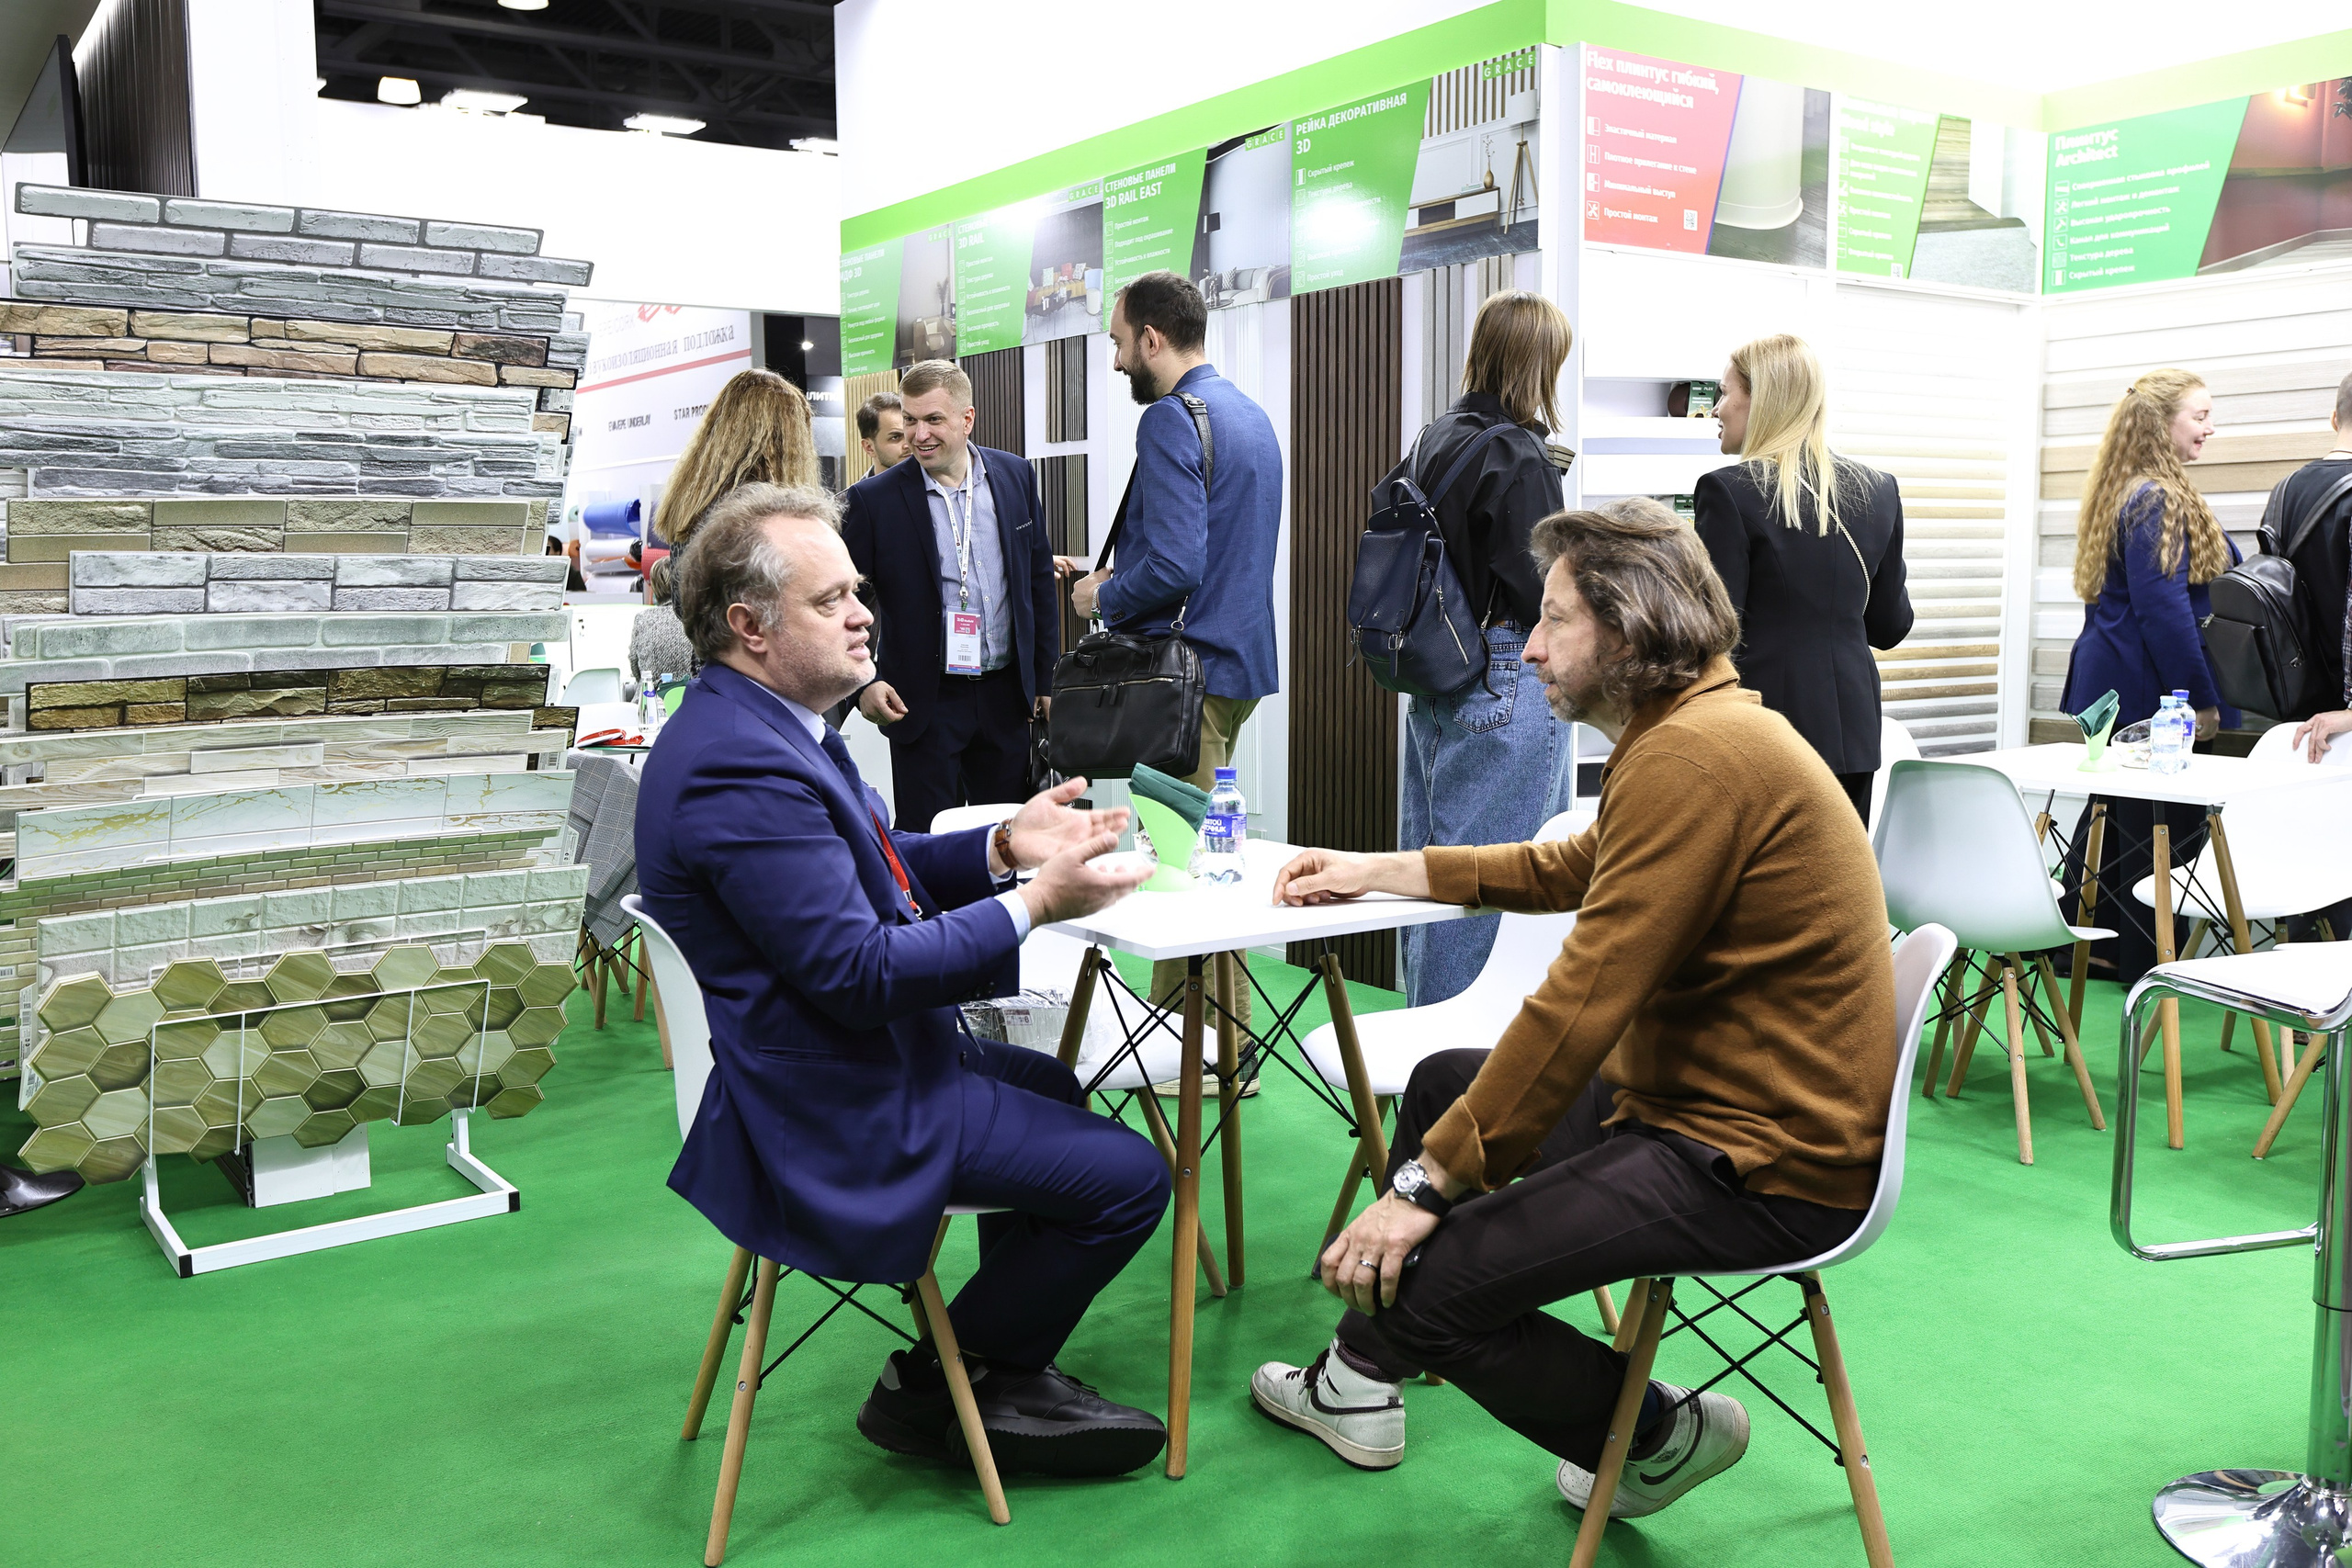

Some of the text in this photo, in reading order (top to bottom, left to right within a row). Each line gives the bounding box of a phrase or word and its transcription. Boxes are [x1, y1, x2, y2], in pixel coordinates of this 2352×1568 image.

[1484, 54, 1533, 77] GRACE
[1587, 50, 1720, 96] Flex плинтус гибкий,
[1587, 77, 1694, 108] самоклеющийся
[1296, 93, 1407, 136] РЕЙКА ДЕКОРАТИВНАЯ
[1246, 130, 1283, 149] GRACE
[1296, 138, 1311, 154] 3D
[2055, 129, 2119, 151] Плинтус
[2055, 144, 2119, 167] Architect
[1307, 164, 1332, 178] Скрытый
[2166, 160, 2210, 176] профилей
[1104, 163, 1176, 192] СТЕНОВЫЕ ПАНЕЛИ
[1069, 186, 1099, 200] GRACE
[1105, 182, 1162, 209] 3D RAIL EAST
[1604, 207, 1658, 223] Простой монтаж
[958, 231, 984, 249] 3D RAIL
[865, 248, 884, 261] ПАНЕЛИ
[2069, 247, 2134, 263] Текстура дерева
[854, 266, 862, 278] 3D
[2068, 265, 2135, 280] Скрытый крепеж
[674, 408, 690, 420] STAR
